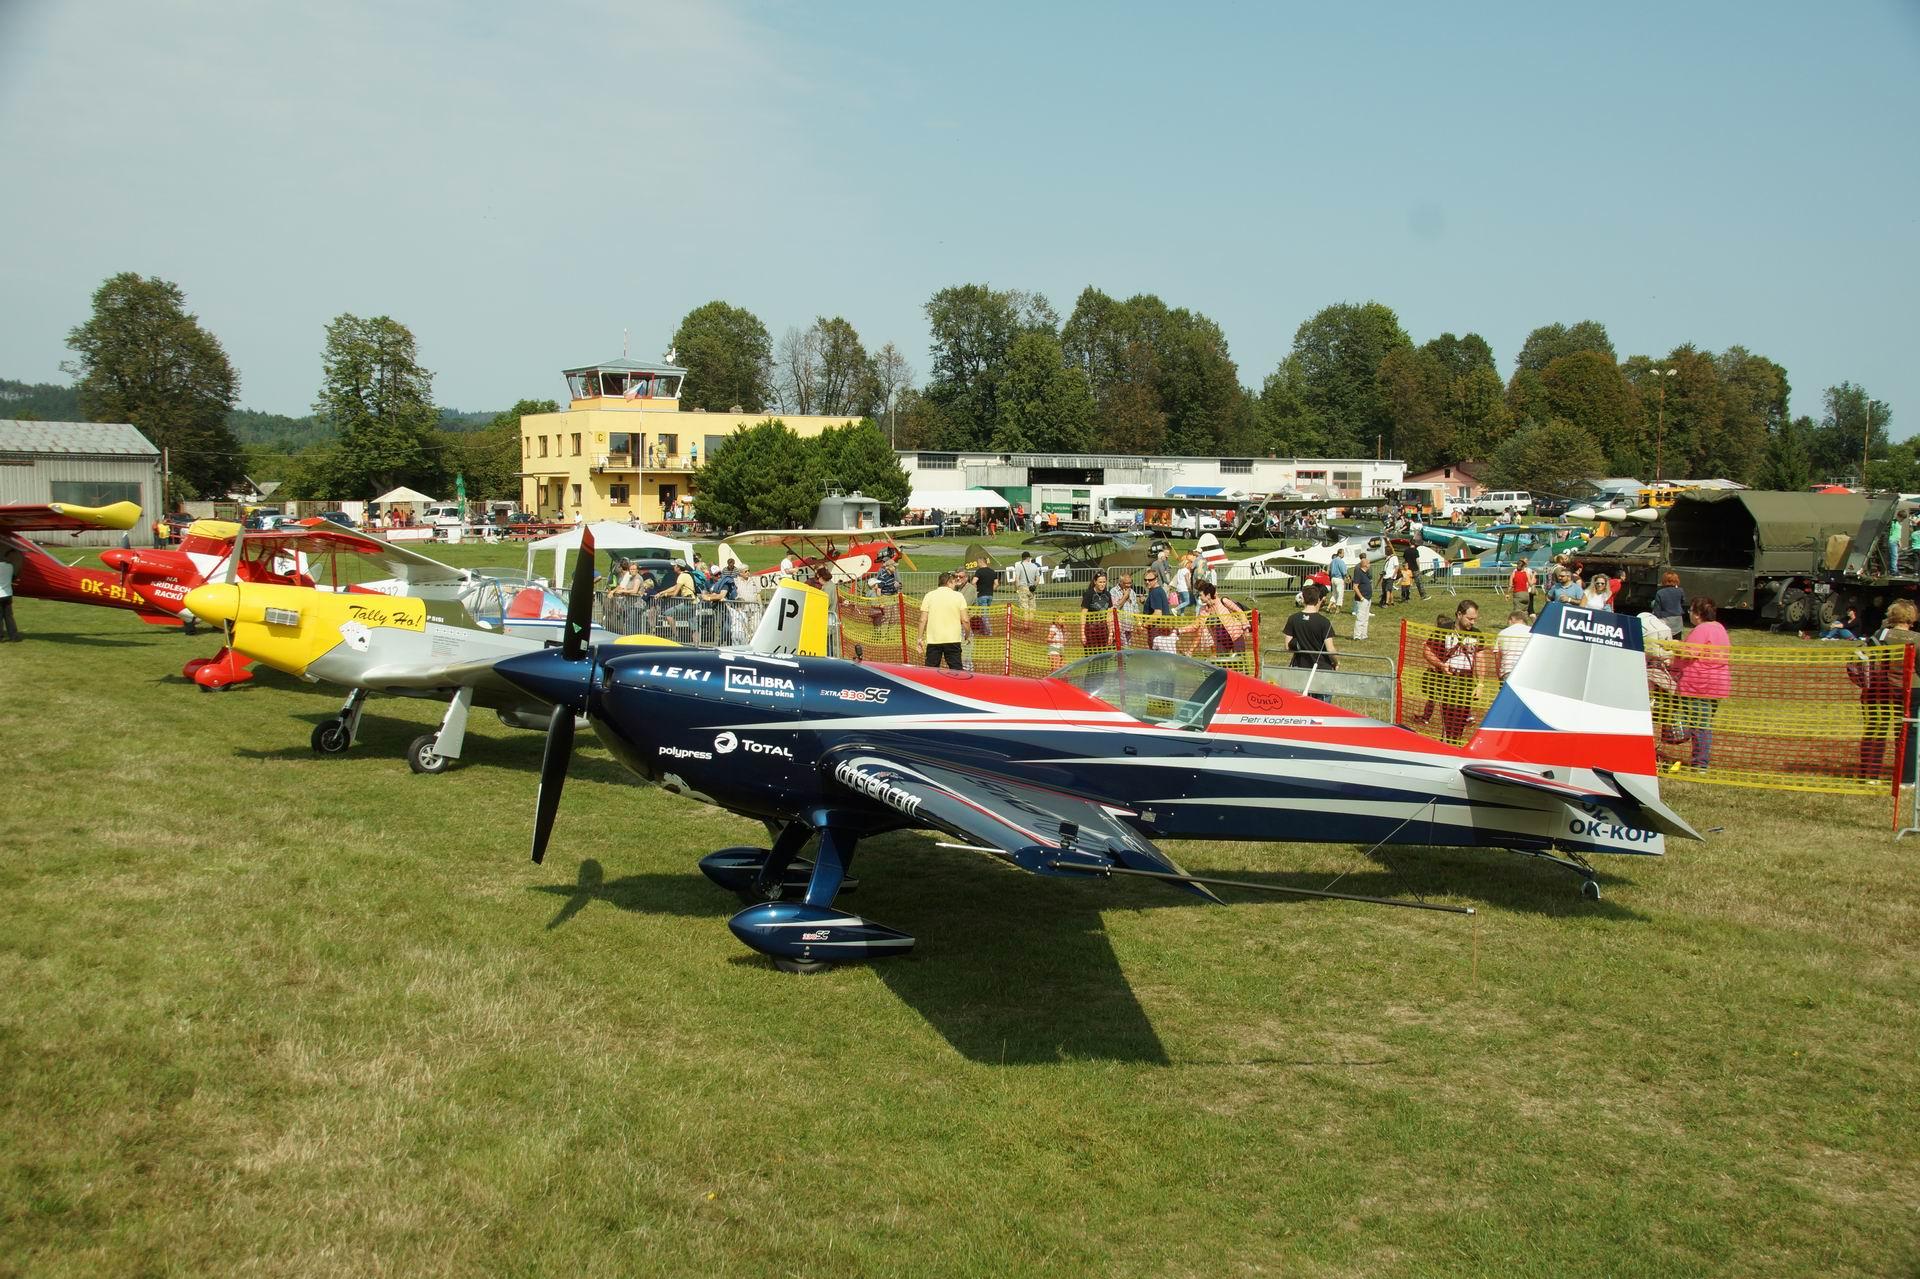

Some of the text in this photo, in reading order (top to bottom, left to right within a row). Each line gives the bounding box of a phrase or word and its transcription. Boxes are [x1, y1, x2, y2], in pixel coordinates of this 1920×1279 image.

[597, 433, 604, 442] C
[349, 605, 422, 627] Tally Ho!
[777, 598, 799, 631] P
[1566, 618, 1624, 640] KALIBRA
[1584, 635, 1623, 648] vrata okna
[650, 664, 712, 682] LEKI
[731, 673, 795, 691] KALIBRA
[752, 688, 794, 699] vrata okna
[1240, 715, 1307, 726] Petr Kopfstein
[658, 746, 713, 760] polypress
[741, 739, 794, 758] TOTAL
[1569, 818, 1658, 844] OK-KOP
